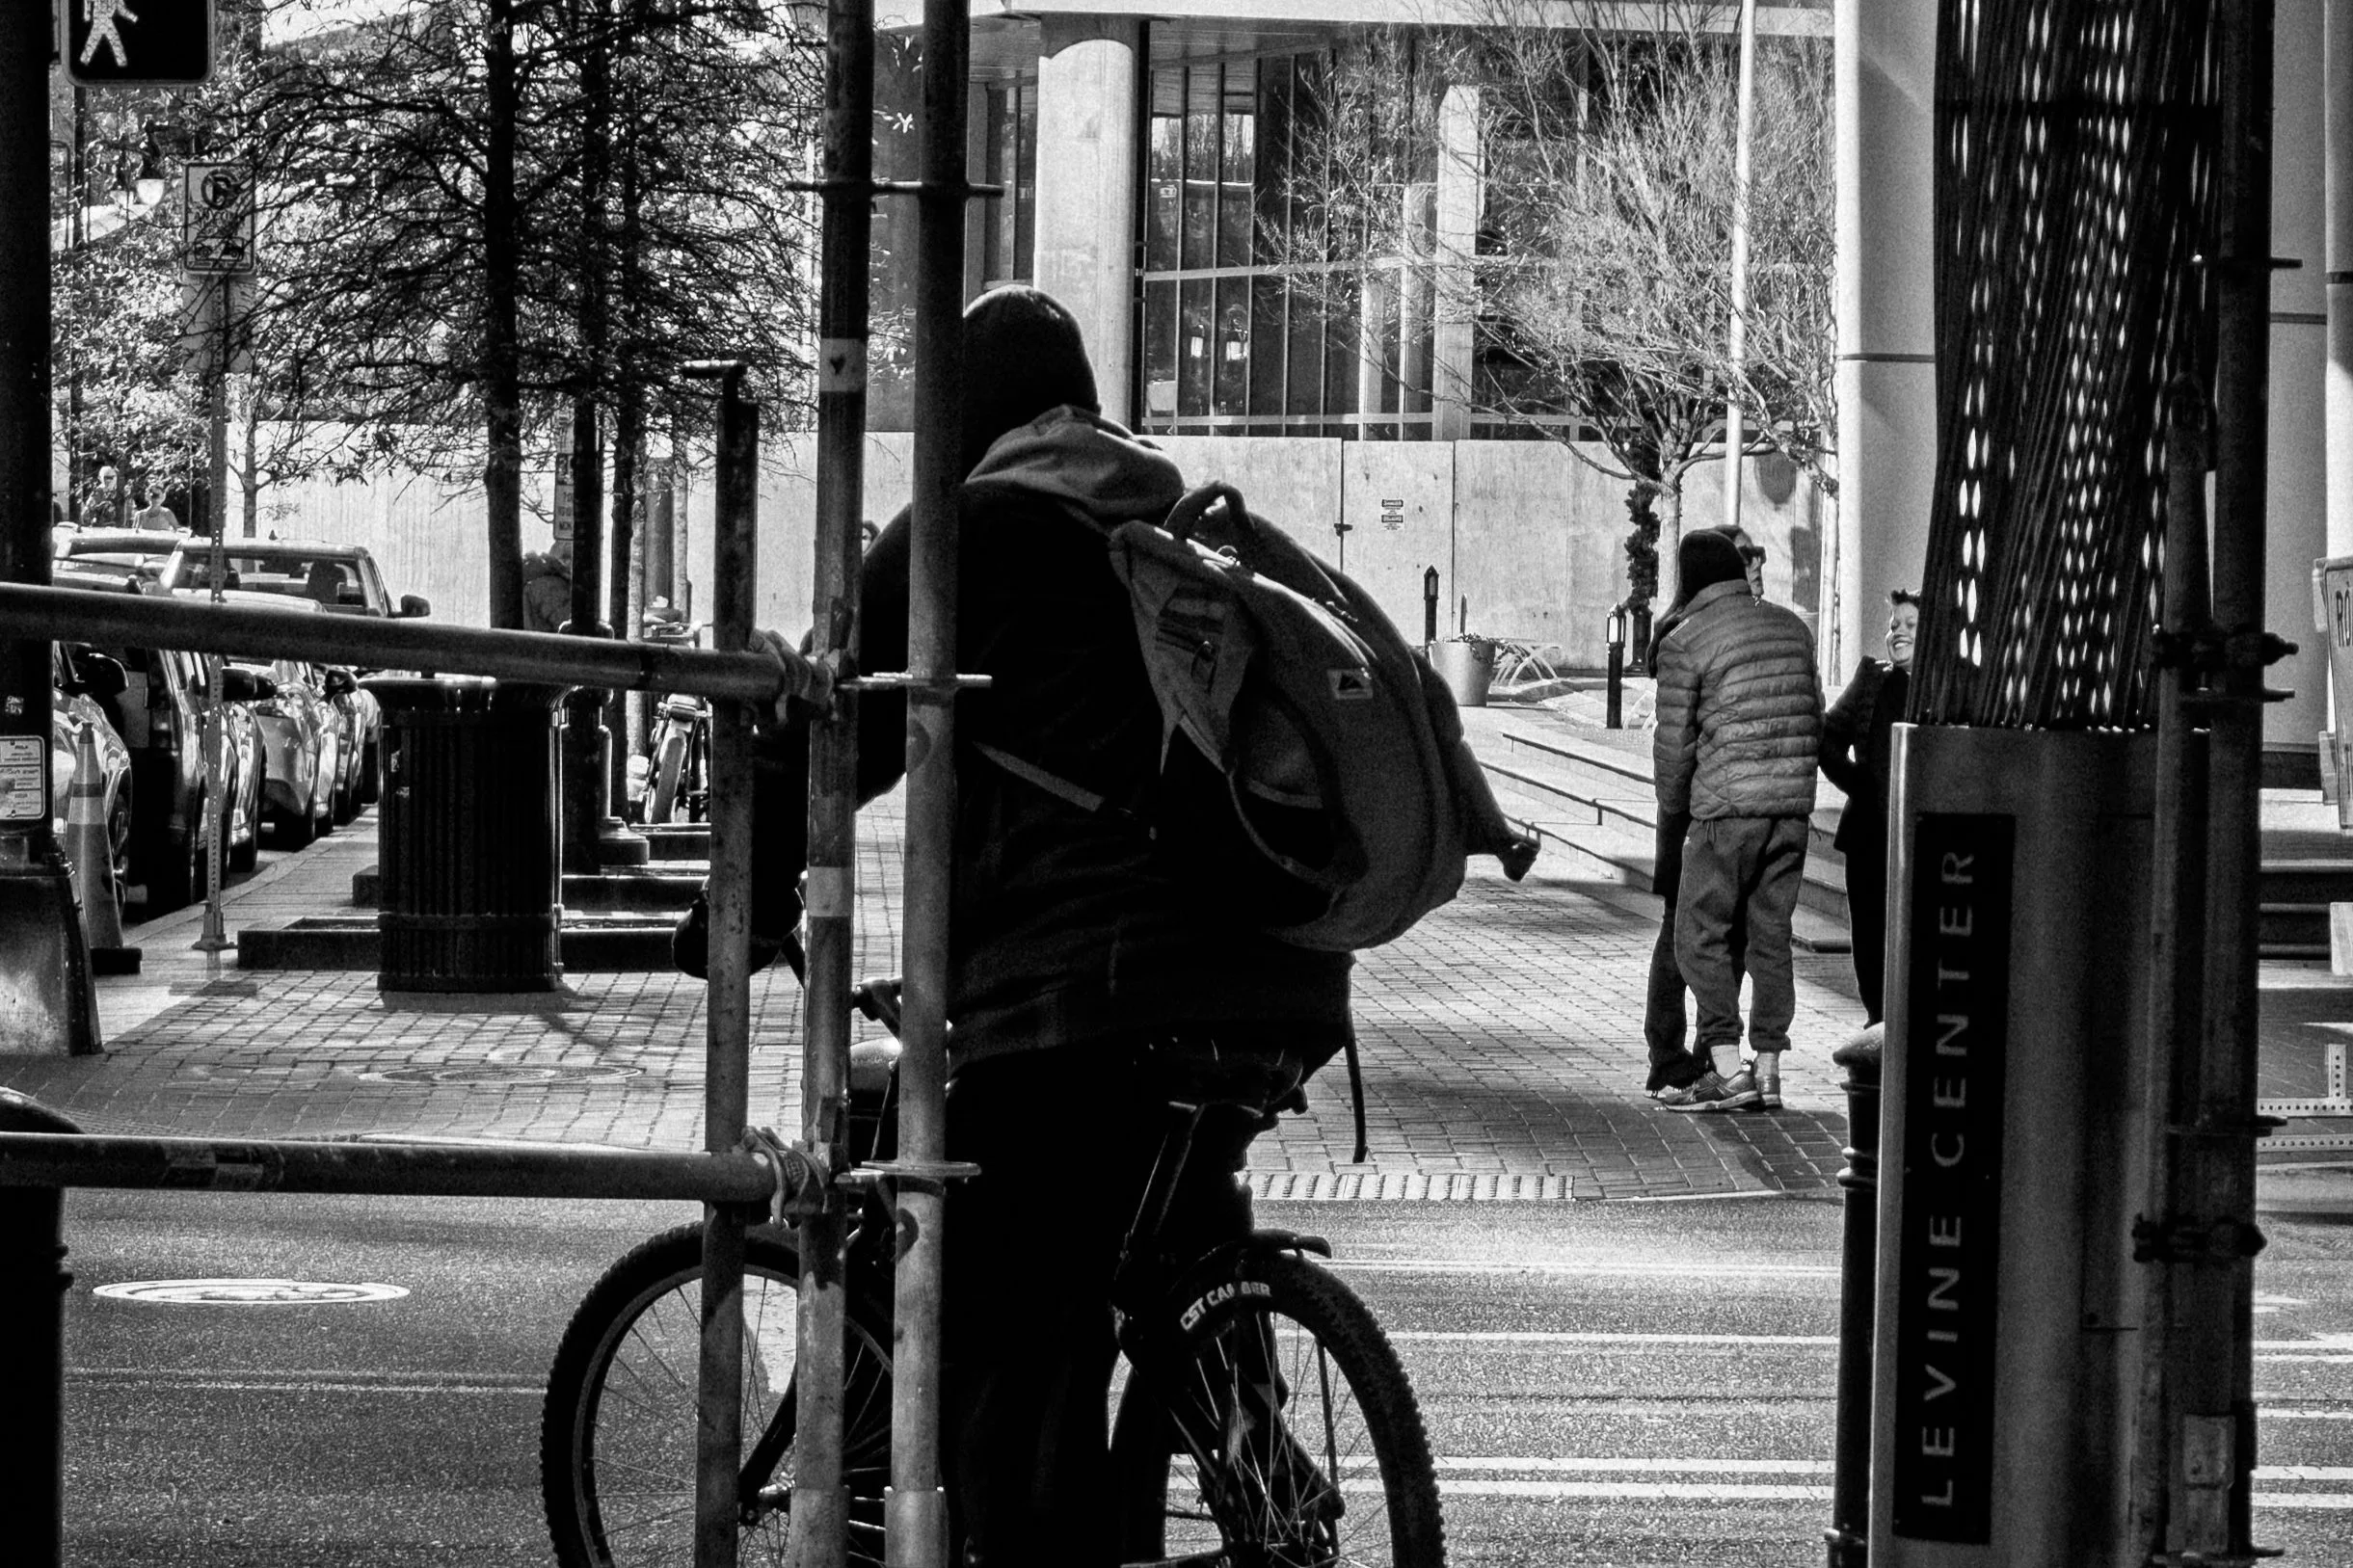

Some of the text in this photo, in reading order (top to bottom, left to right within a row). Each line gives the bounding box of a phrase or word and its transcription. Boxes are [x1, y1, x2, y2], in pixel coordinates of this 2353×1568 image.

[1180, 1296, 1206, 1331] CST
[1921, 852, 1975, 1506] LEVINE CENTER
